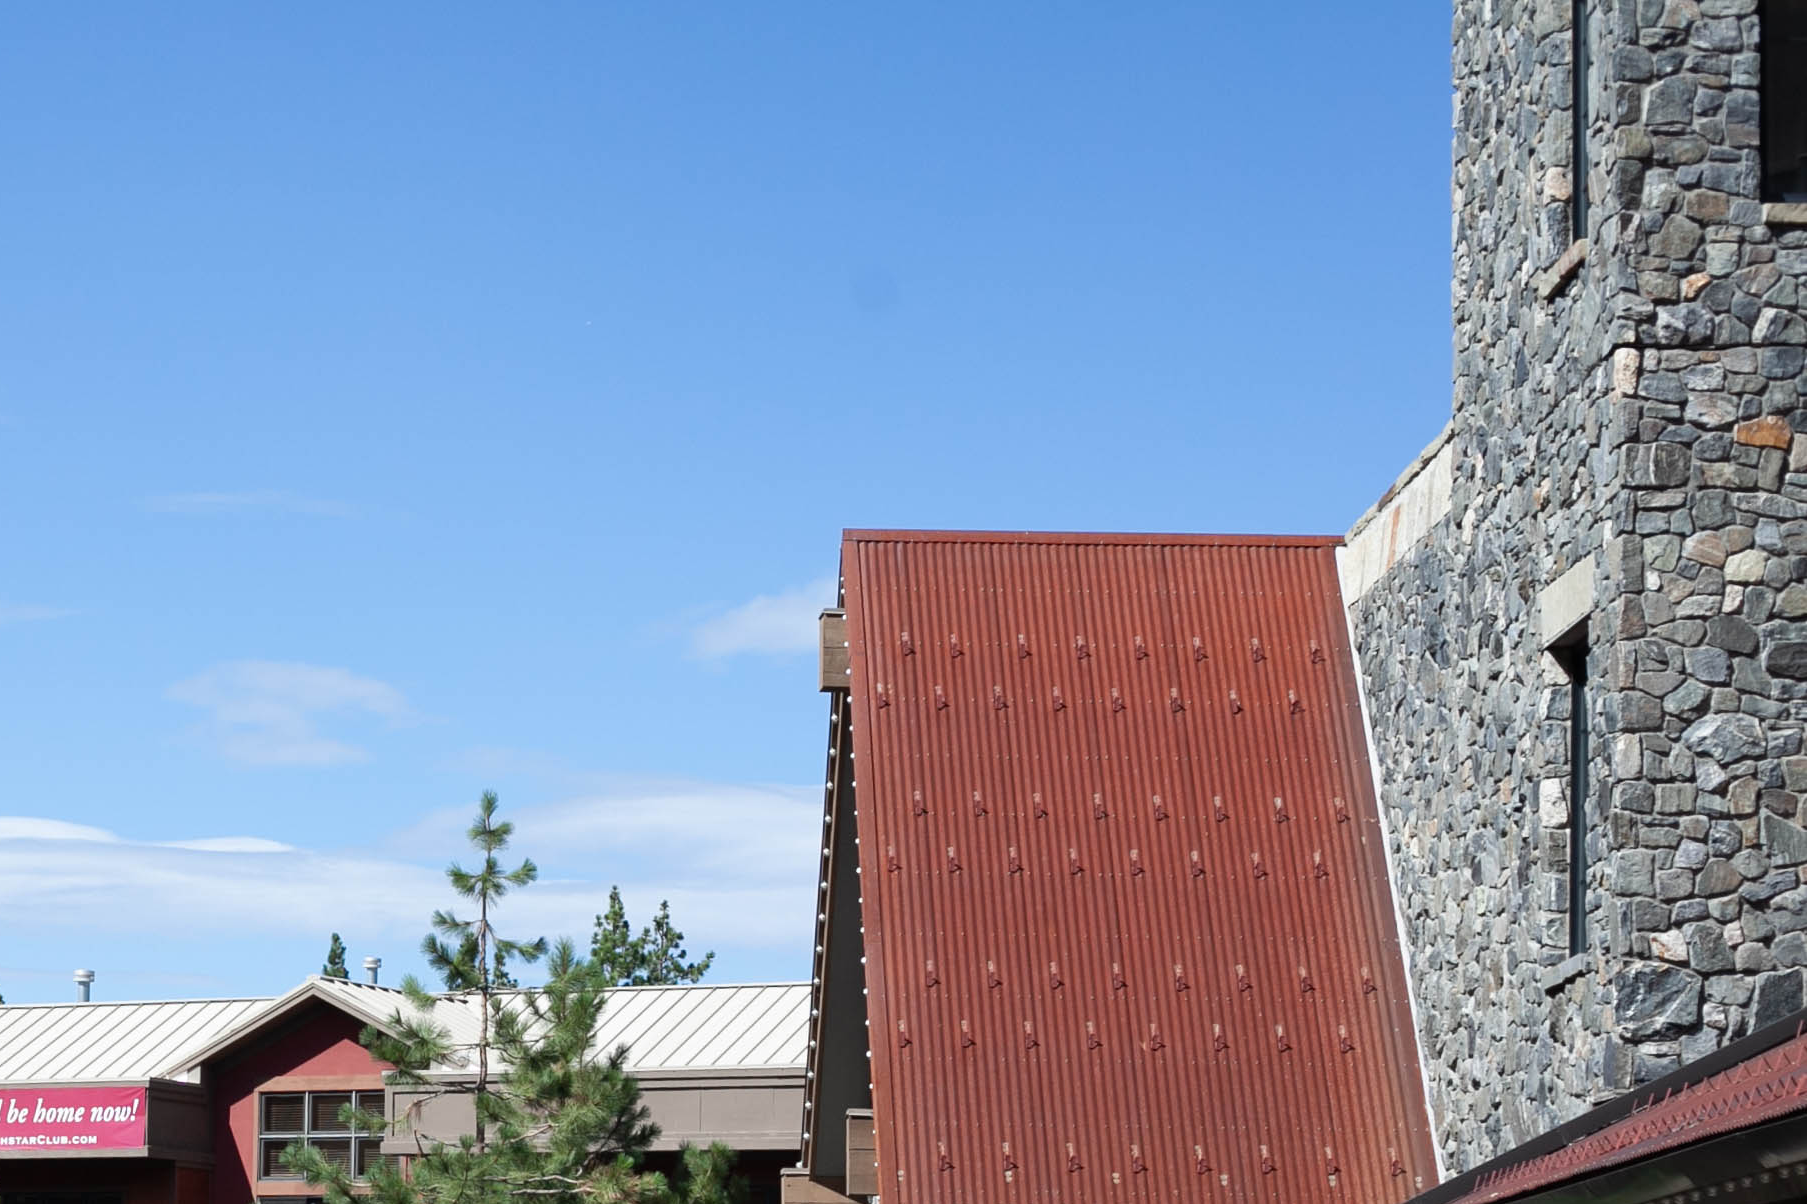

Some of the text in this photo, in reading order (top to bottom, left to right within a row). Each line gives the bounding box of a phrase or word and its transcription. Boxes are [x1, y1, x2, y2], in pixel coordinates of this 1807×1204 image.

[6, 1098, 29, 1123] be
[32, 1097, 85, 1123] home
[90, 1098, 140, 1122] now!
